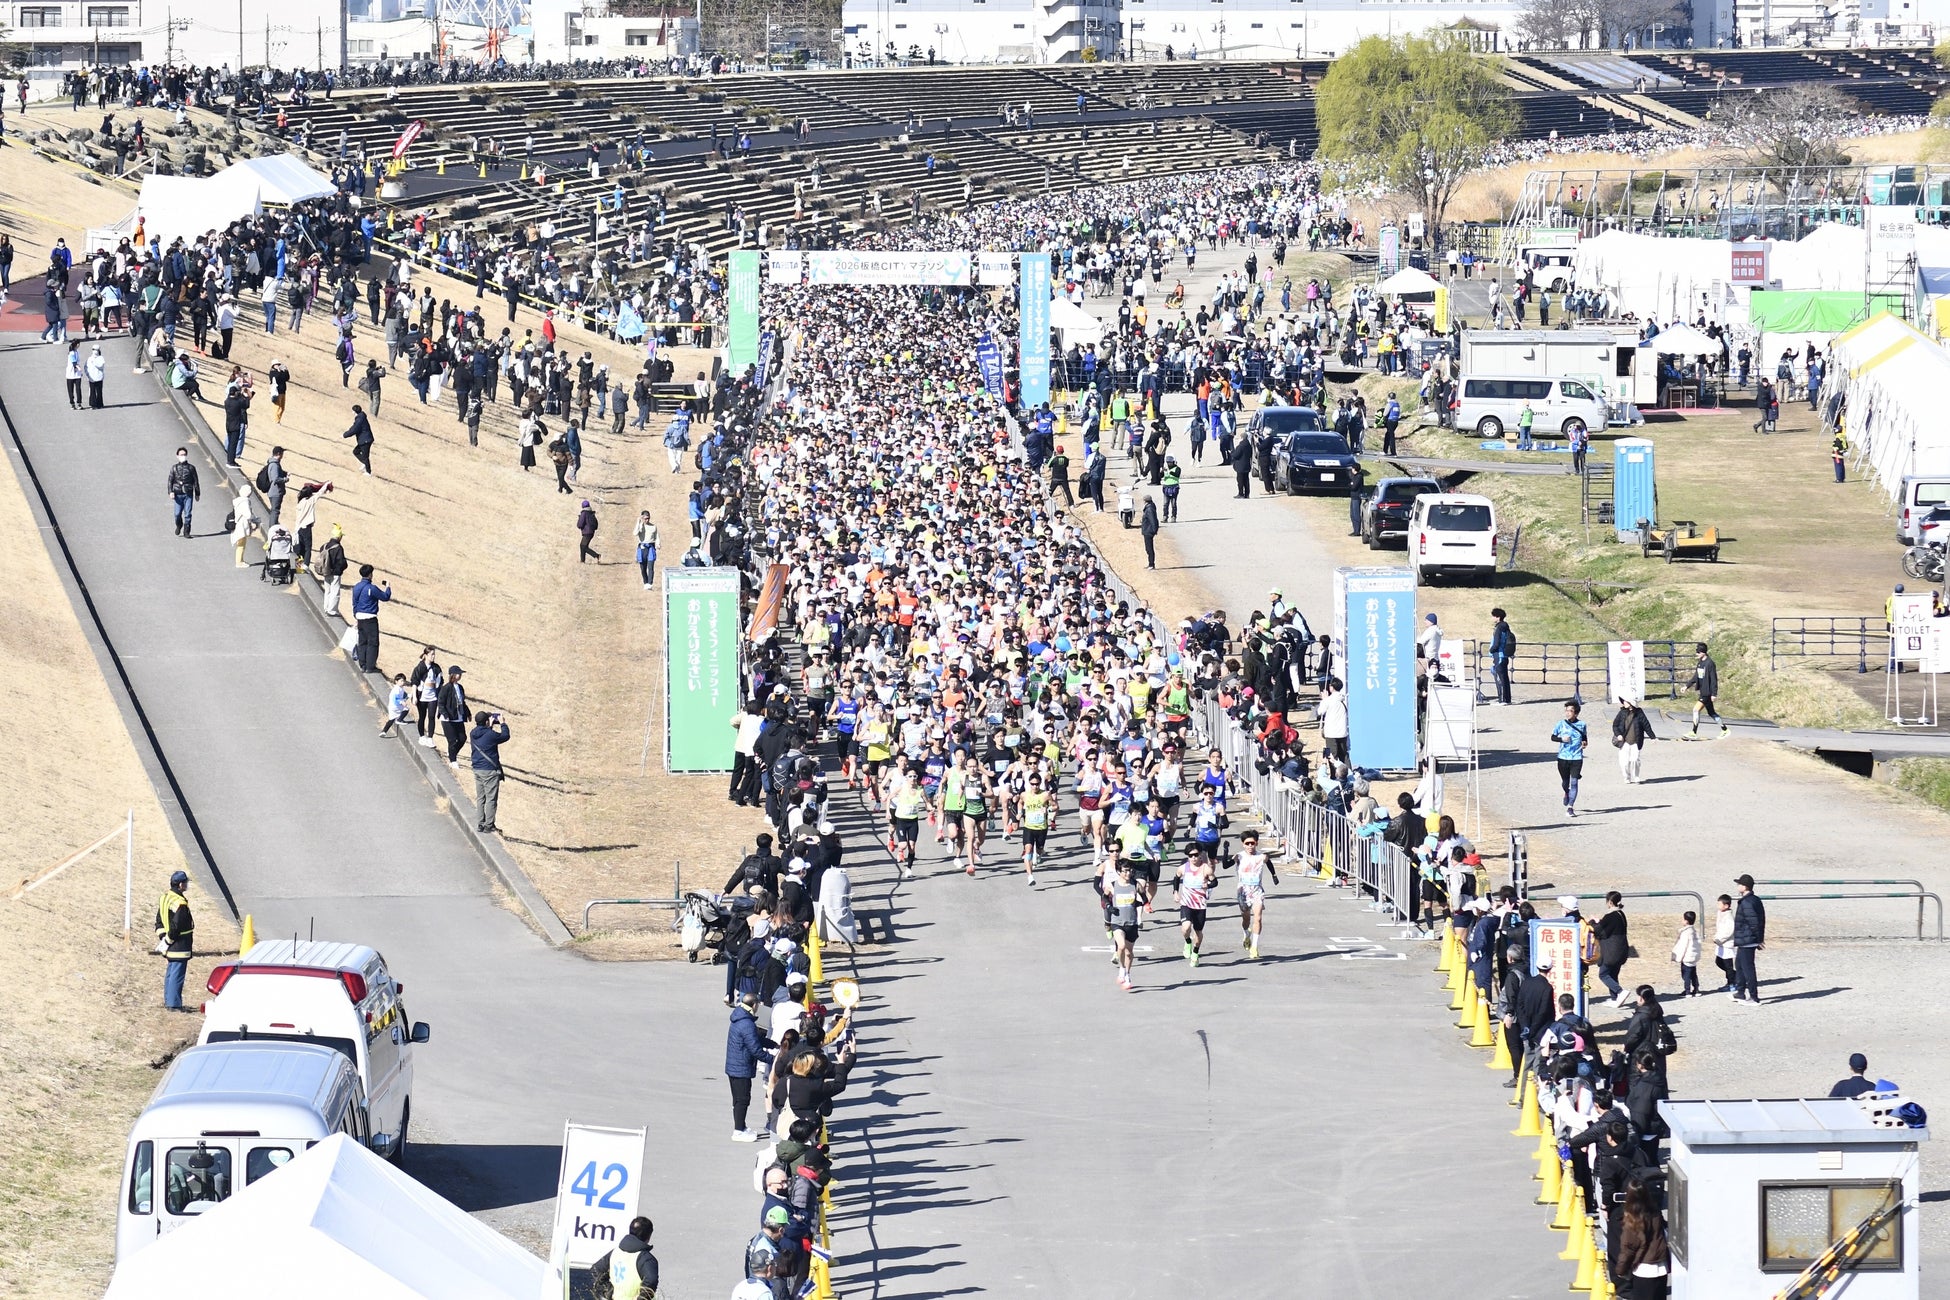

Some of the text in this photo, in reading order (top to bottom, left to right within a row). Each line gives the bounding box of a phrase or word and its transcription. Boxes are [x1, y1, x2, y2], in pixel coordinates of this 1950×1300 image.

[1898, 625, 1930, 635] TOILET
[1903, 613, 1926, 622] トイレ
[688, 599, 702, 691] おかえりなさい
[1366, 598, 1379, 690] おかえりなさい
[1541, 928, 1573, 944] 危険
[1562, 948, 1573, 992] 自転車は
[570, 1160, 629, 1211] 42
[573, 1215, 616, 1242] km
